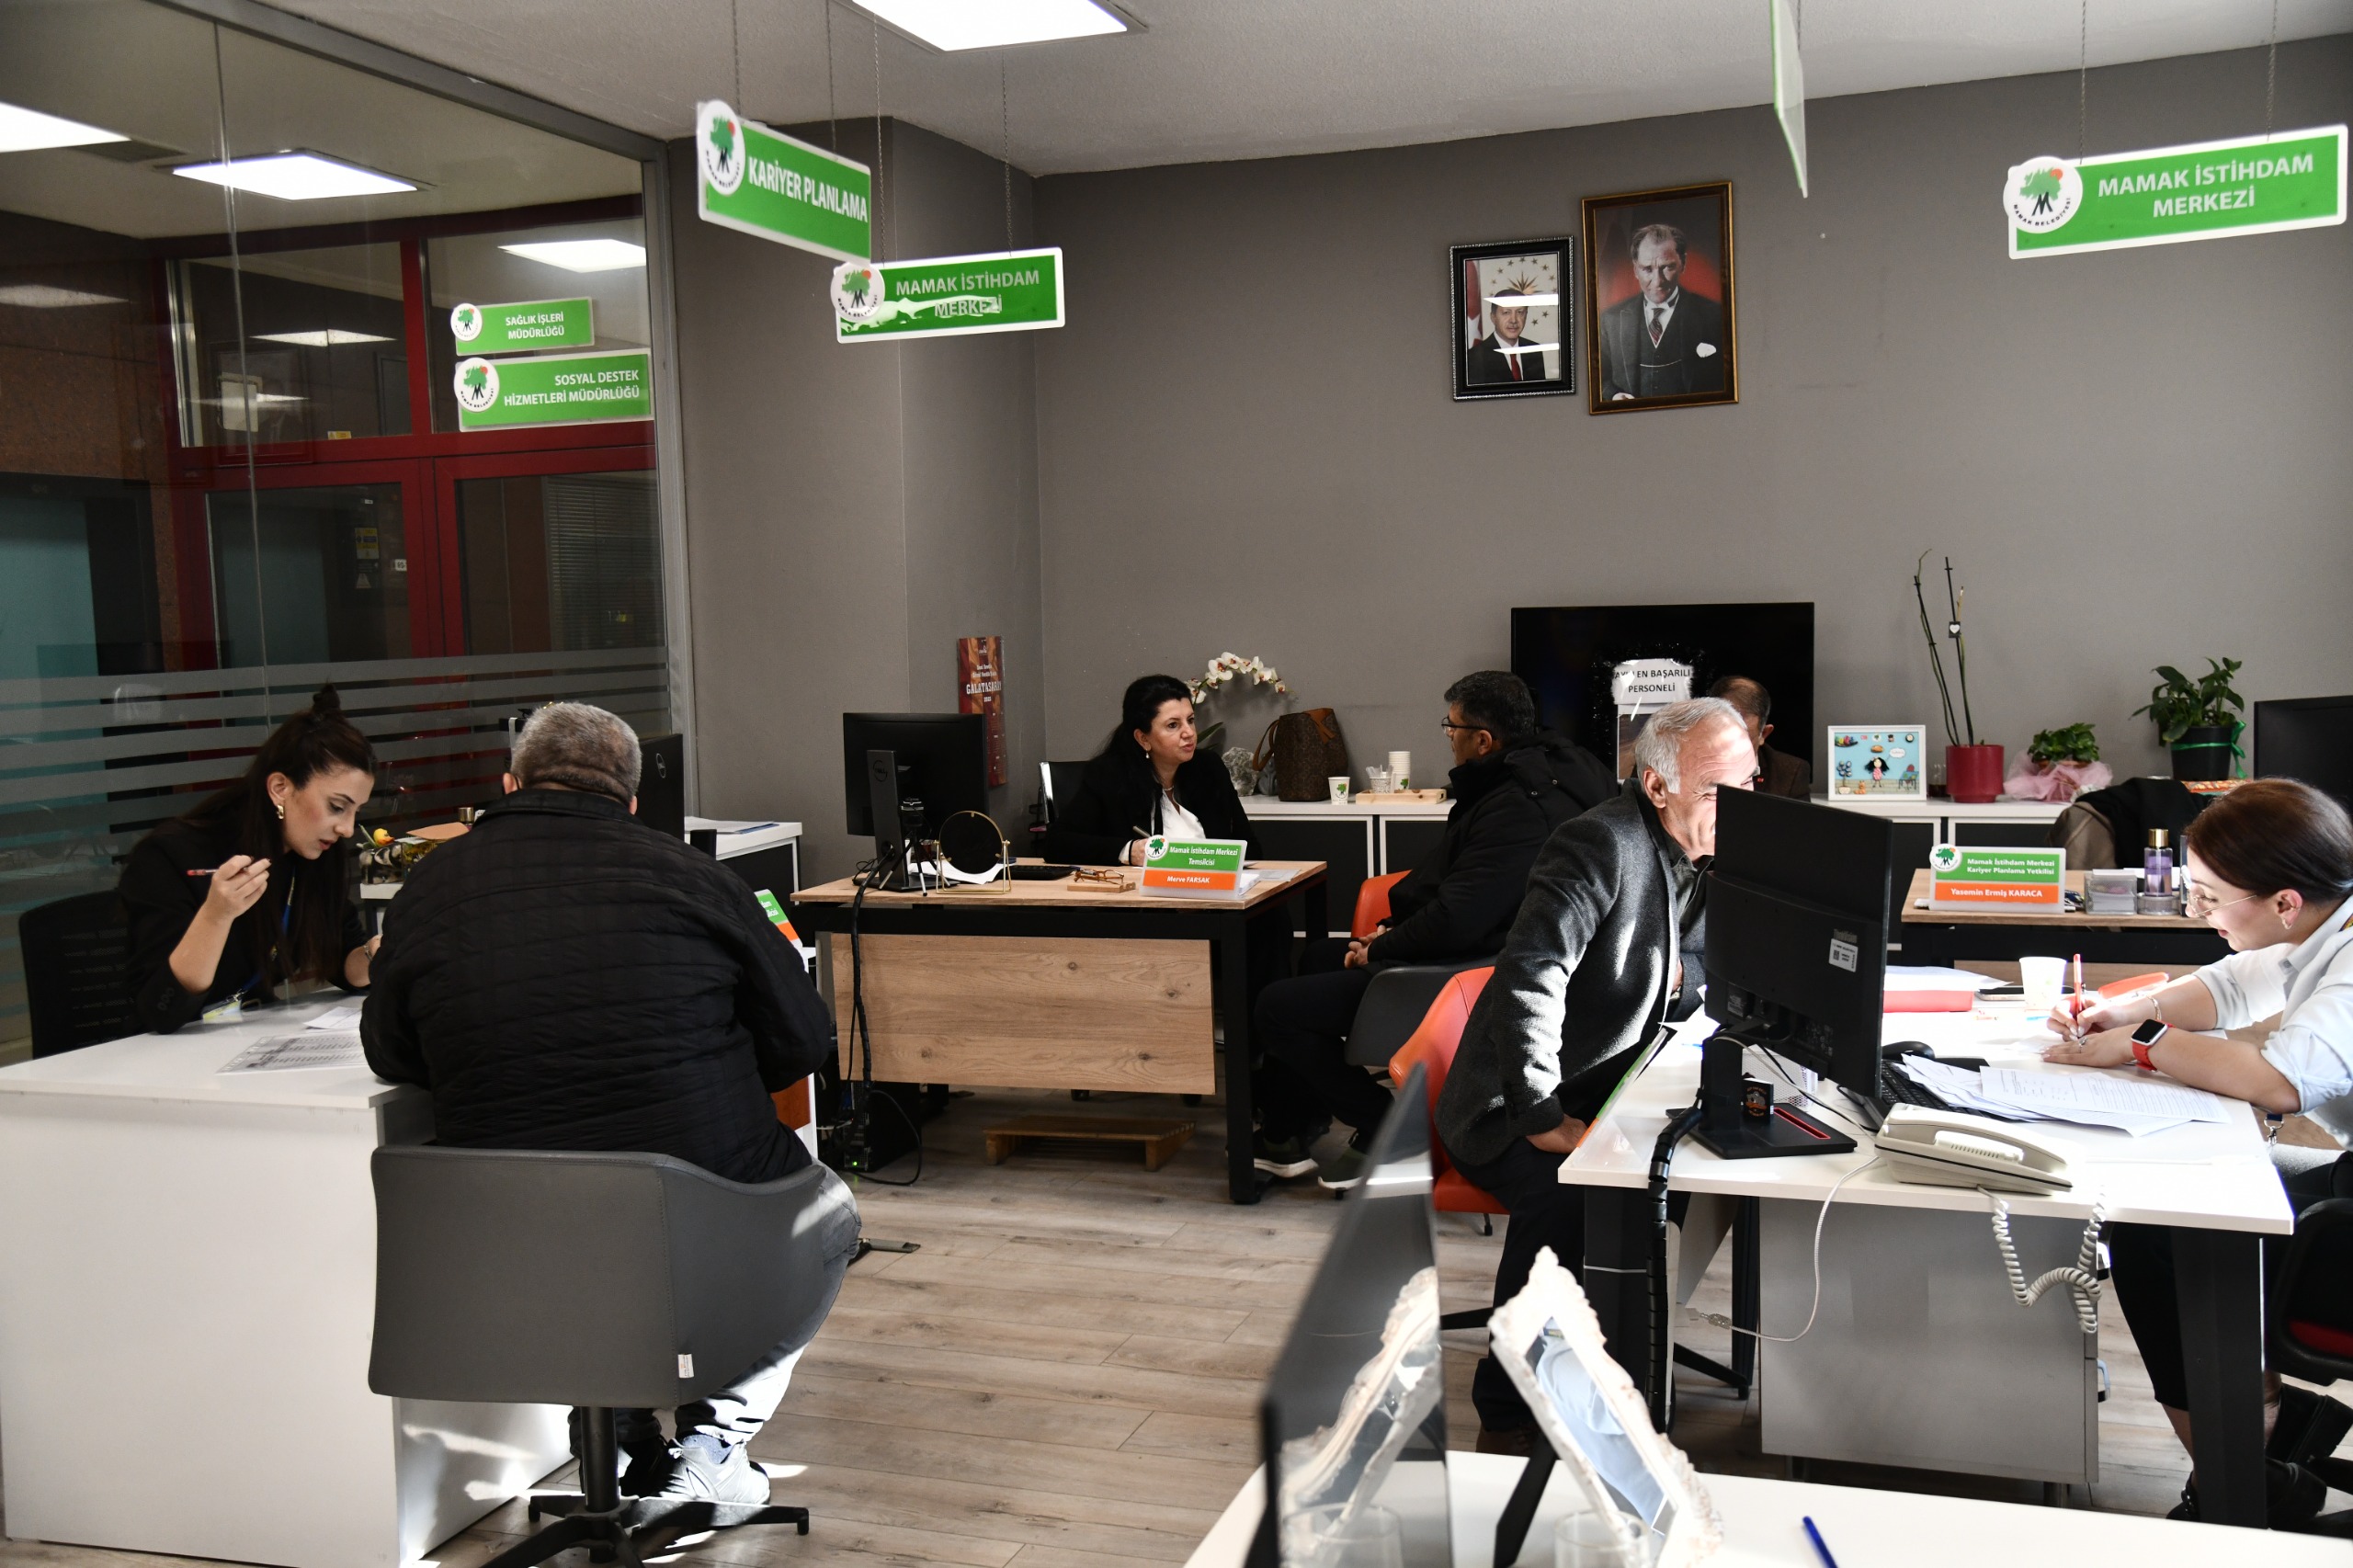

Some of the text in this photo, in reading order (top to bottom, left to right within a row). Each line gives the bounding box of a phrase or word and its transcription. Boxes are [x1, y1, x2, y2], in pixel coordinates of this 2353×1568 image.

[2097, 153, 2313, 198] MAMAK İSTİHDAM
[748, 156, 868, 223] KARİYER PLANLAMA
[2153, 186, 2255, 218] MERKEZİ
[896, 270, 1040, 297] MAMAK İSTİHDAM
[506, 312, 564, 326] SAĞLIK İŞLERİ
[508, 324, 564, 340] MÜDÜRLÜĞÜ
[555, 369, 640, 386] SOSYAL DESTEK
[504, 385, 640, 406] HİZMETLERİ MÜDÜRLÜĞÜ
[1637, 670, 1648, 678] EN
[1650, 669, 1690, 678] BAŞARILI
[1628, 682, 1676, 693] PERSONELİ
[1190, 846, 1215, 855] İstihdam
[1995, 858, 2025, 866] İstihdam
[1967, 866, 1992, 874] Kariyer
[2026, 867, 2055, 875] Yetkilisi
[1950, 888, 2043, 898] Yasemin Ermiş KARACA
